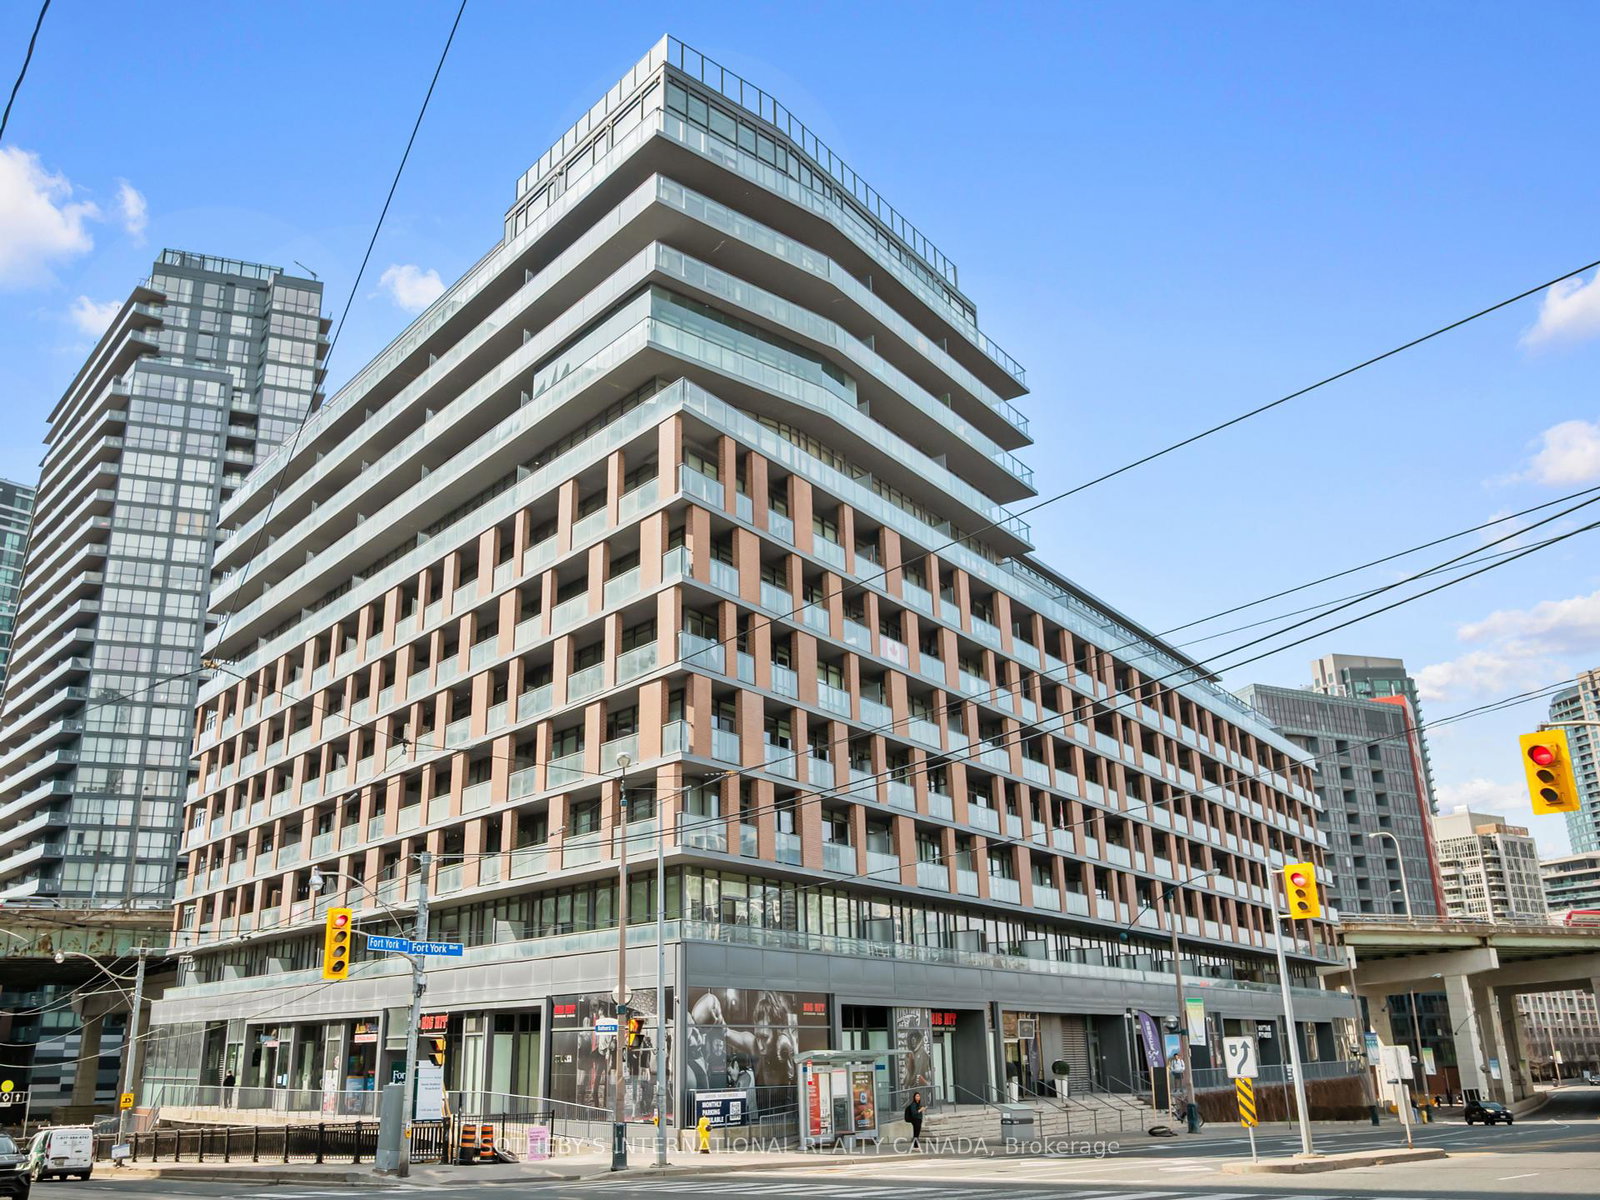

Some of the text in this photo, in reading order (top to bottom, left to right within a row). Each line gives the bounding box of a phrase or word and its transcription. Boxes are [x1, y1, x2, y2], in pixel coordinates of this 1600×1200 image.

[370, 937, 383, 948] Fort
[385, 939, 399, 949] York
[411, 943, 428, 953] Fort
[430, 943, 447, 954] York
